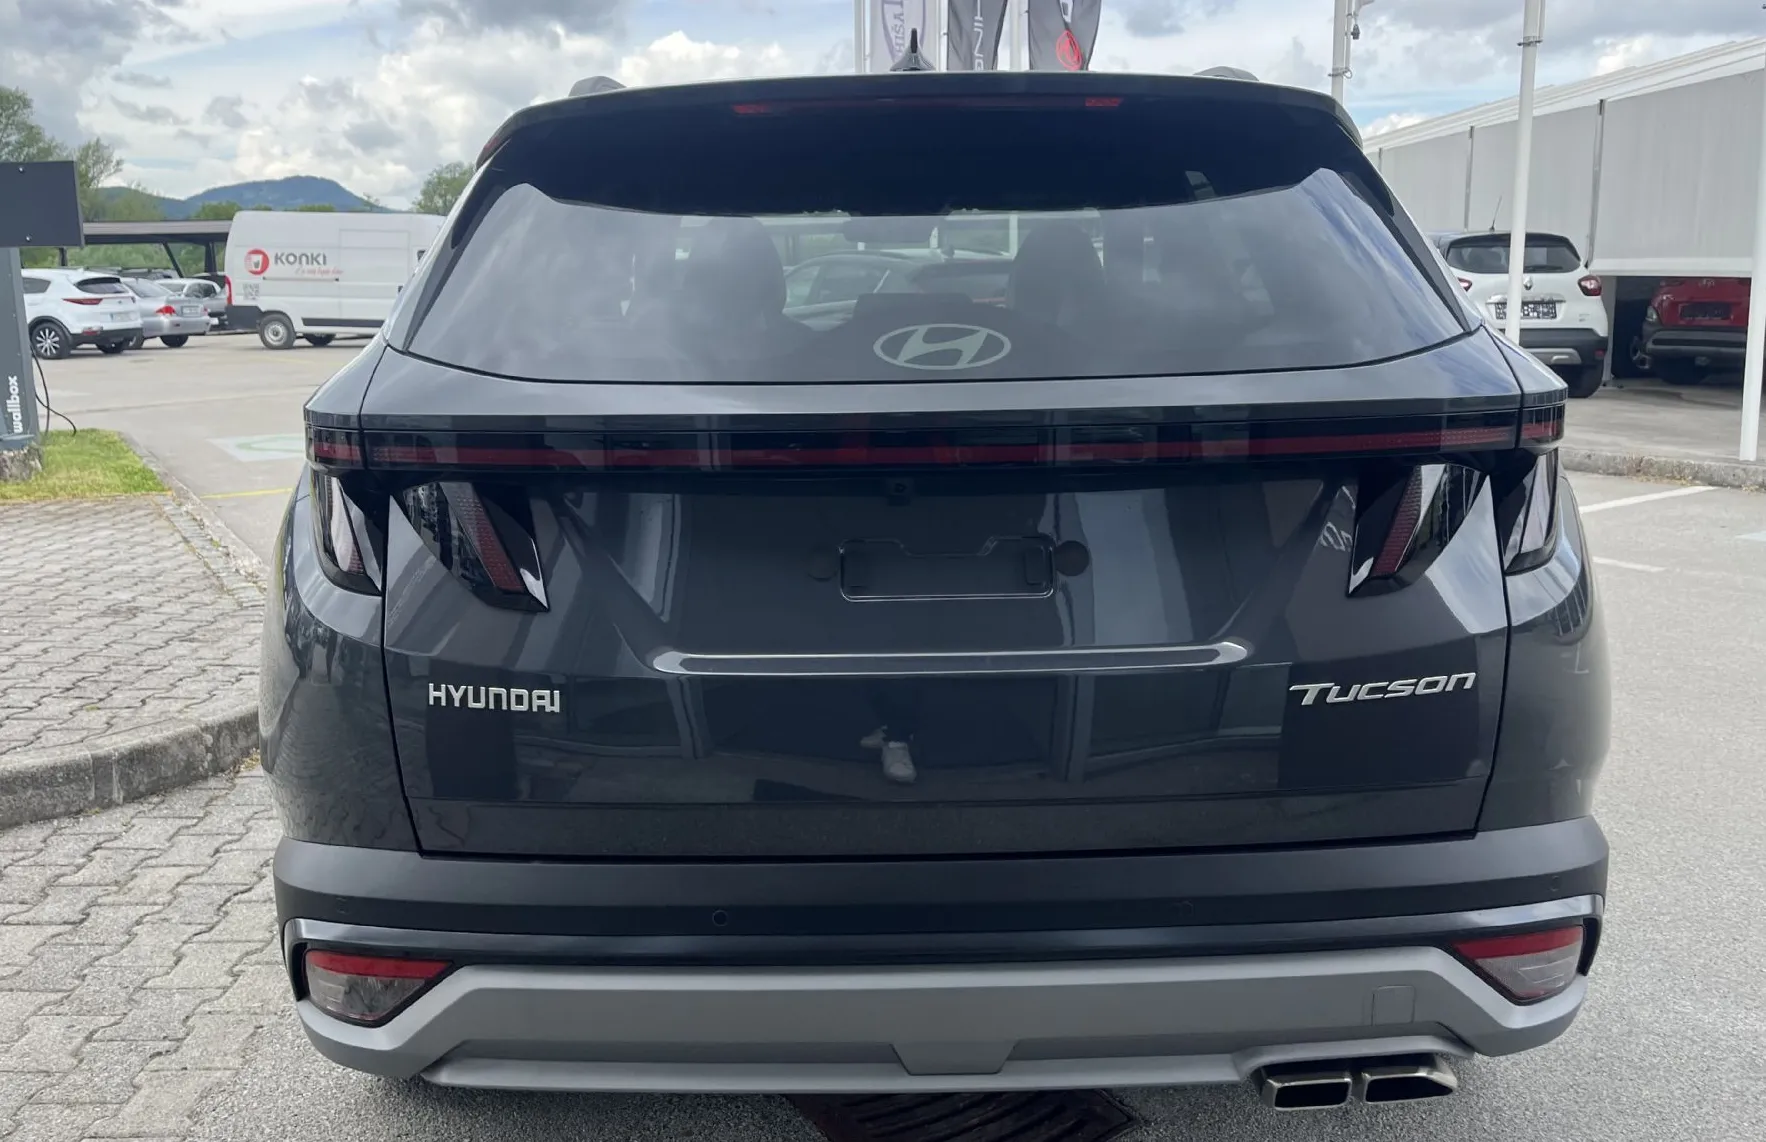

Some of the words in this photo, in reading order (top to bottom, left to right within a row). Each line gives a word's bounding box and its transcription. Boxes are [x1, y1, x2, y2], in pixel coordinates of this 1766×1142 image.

[274, 252, 326, 266] KONKI
[6, 375, 23, 433] wallbox
[428, 683, 560, 713] HYUNDAI
